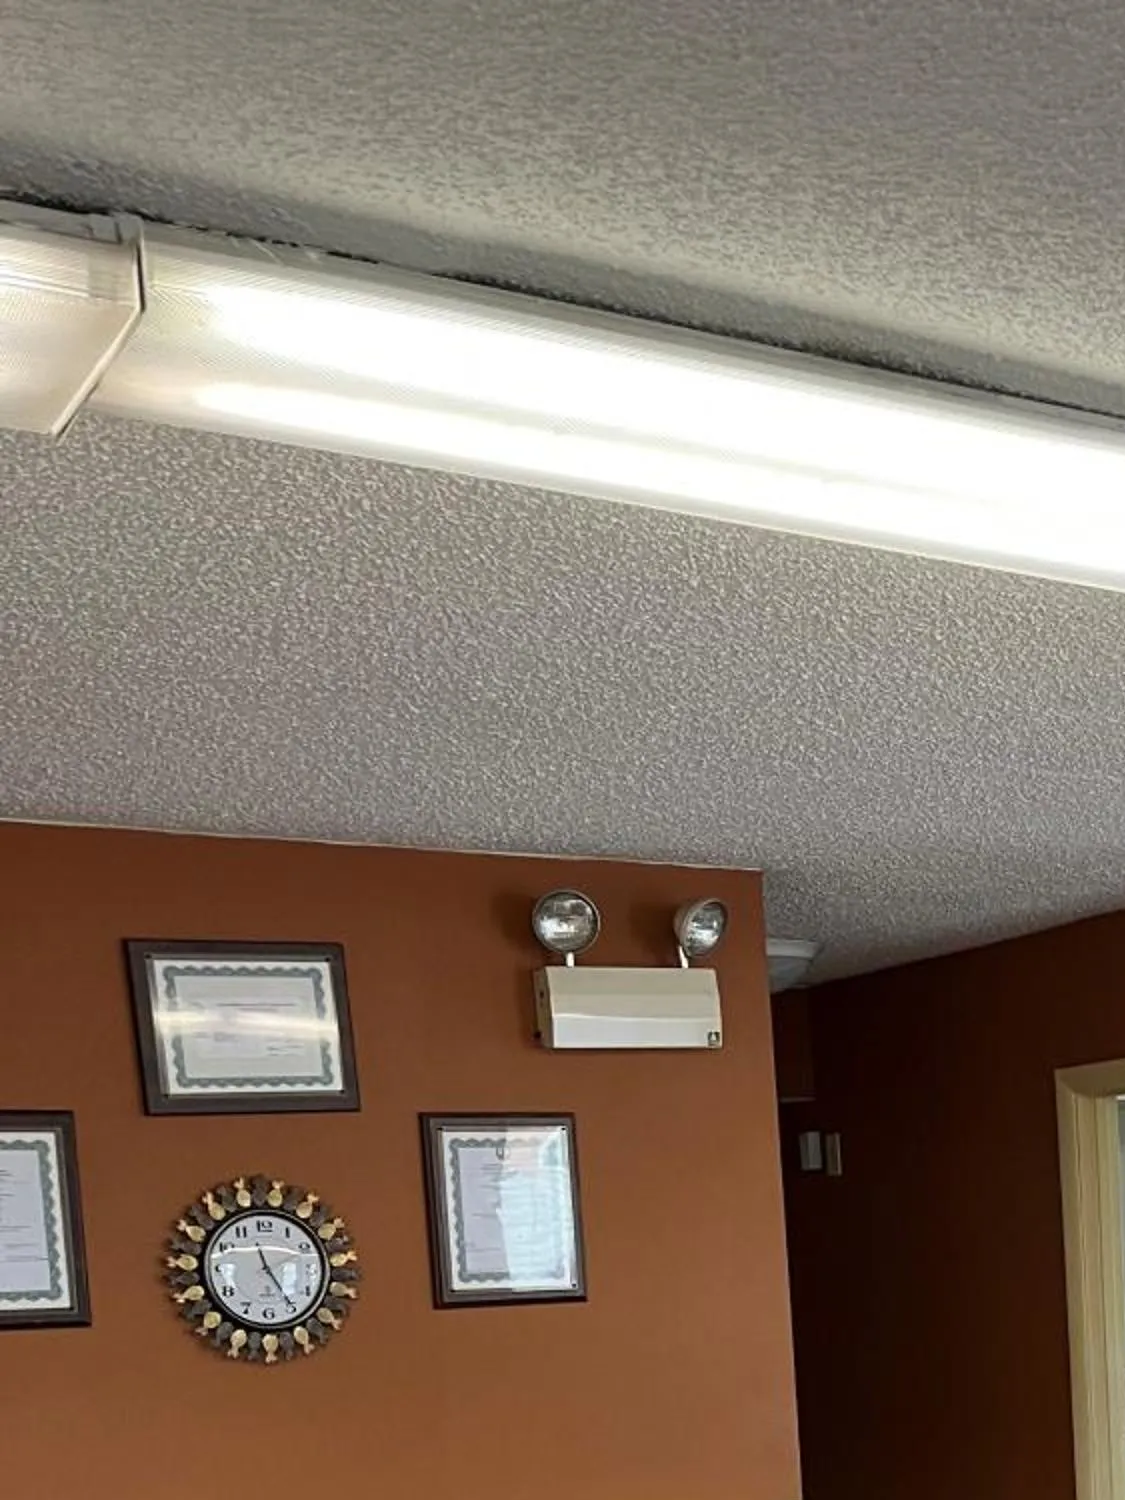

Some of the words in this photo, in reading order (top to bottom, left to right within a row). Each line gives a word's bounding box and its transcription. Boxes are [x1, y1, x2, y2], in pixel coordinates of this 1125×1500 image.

[235, 1226, 248, 1238] 11
[240, 1301, 251, 1314] 7
[262, 1307, 275, 1319] 6
